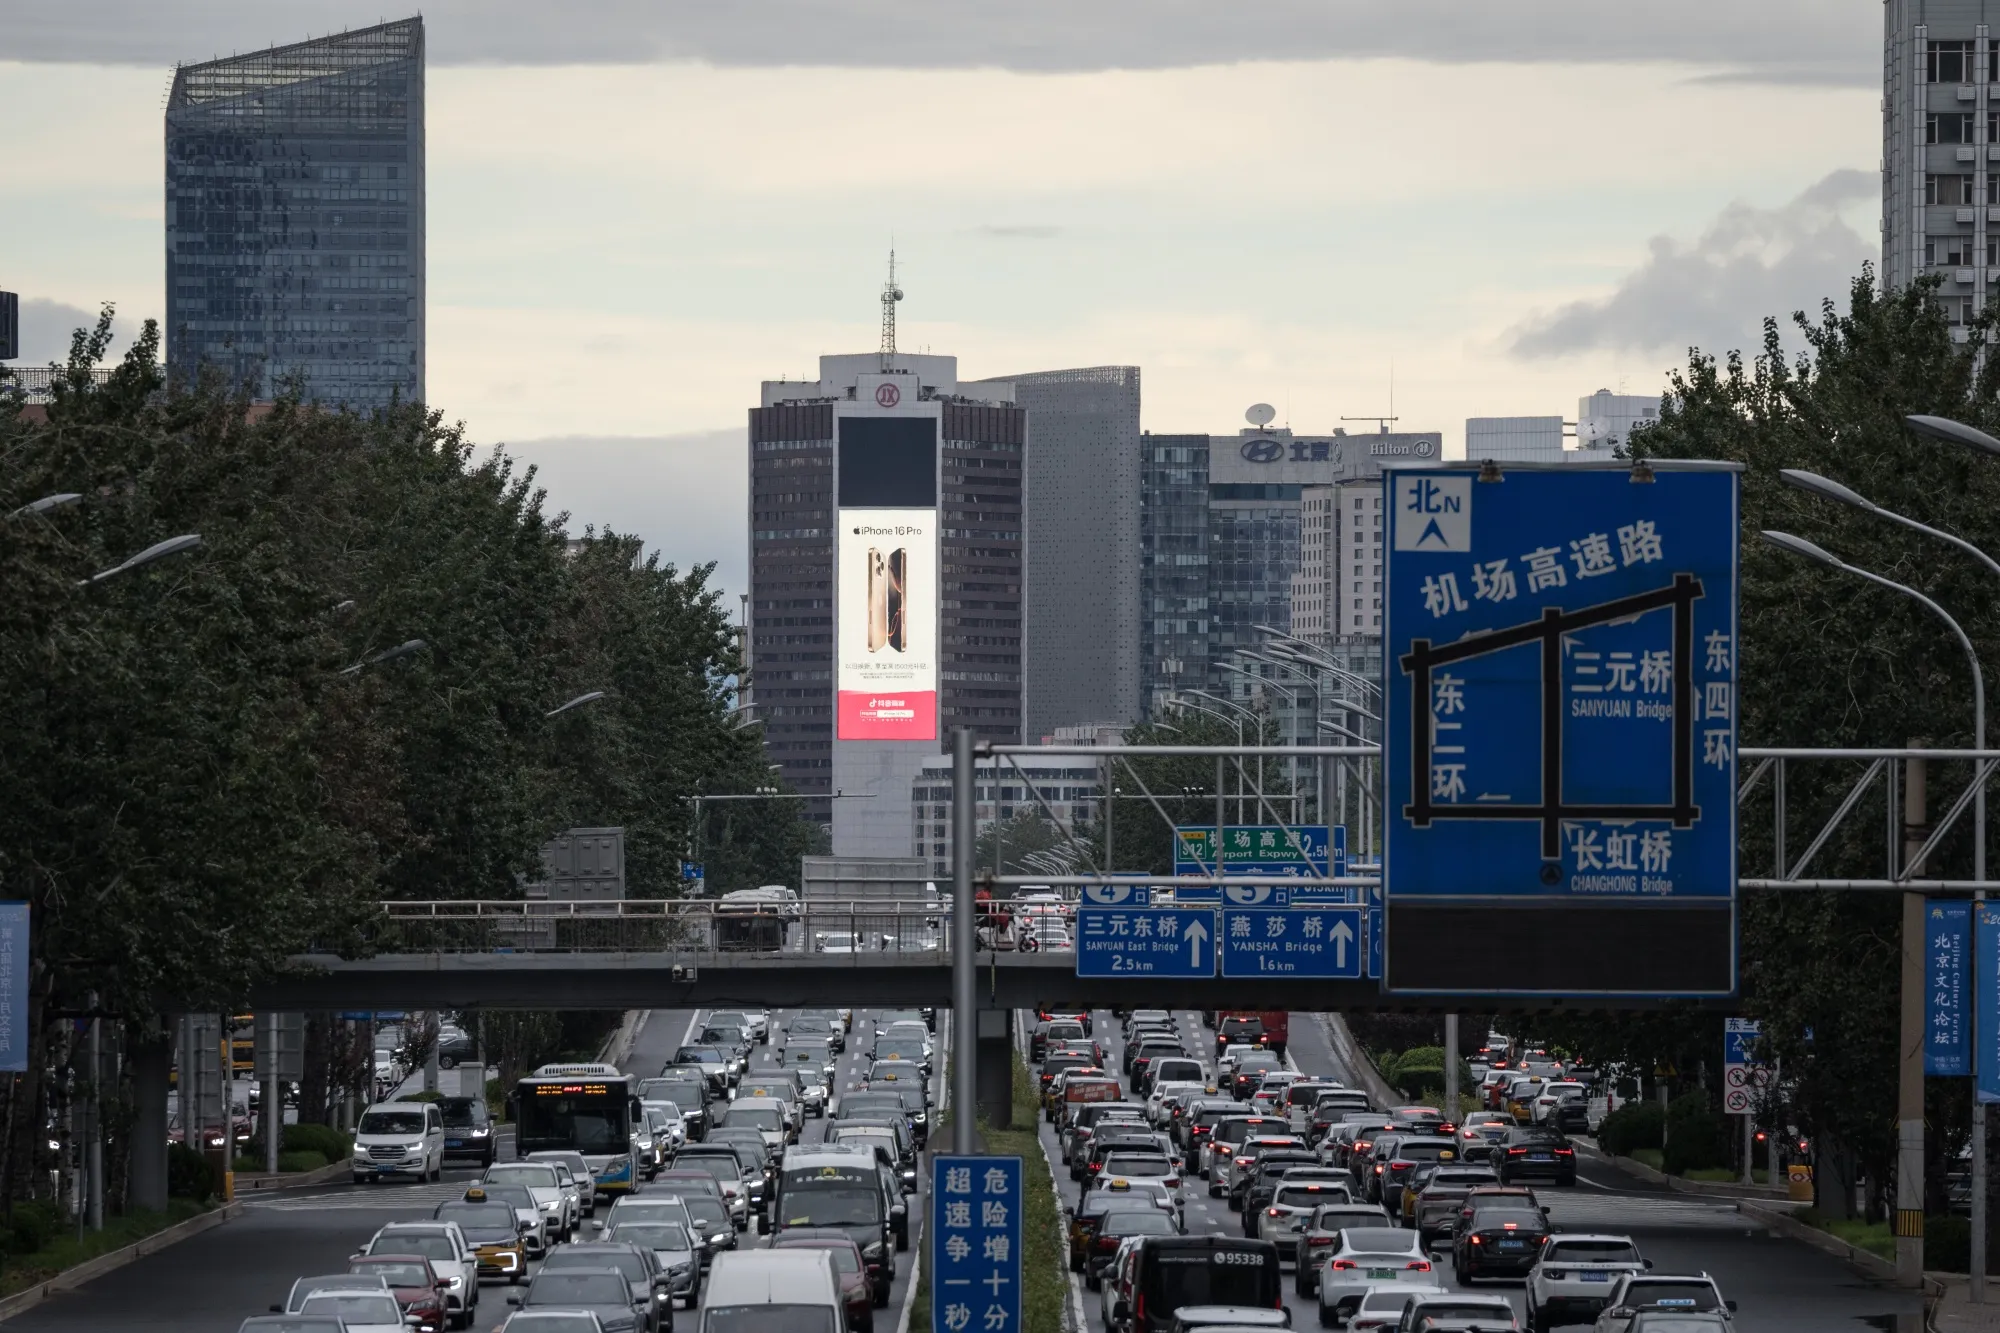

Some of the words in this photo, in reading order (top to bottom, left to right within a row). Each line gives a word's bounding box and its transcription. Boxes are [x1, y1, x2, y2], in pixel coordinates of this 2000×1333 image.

[1370, 443, 1409, 456] Hilton
[1407, 478, 1442, 514] 北
[1443, 496, 1460, 513] N
[861, 527, 893, 535] iPhone
[895, 526, 905, 536] 16
[906, 527, 922, 535] Pro
[1420, 519, 1664, 618] 机场高速路
[1571, 650, 1673, 695] 三元桥
[1571, 700, 1631, 718] SANYUAN
[1636, 699, 1673, 720] Bridge
[1704, 630, 1731, 770] 东四环
[1432, 673, 1466, 803] 东二环
[1259, 850, 1298, 859] Expwy
[1571, 829, 1673, 873] 长虹桥
[1571, 875, 1637, 893] CHANGHONG
[1641, 875, 1673, 894] Bridge
[1084, 915, 1178, 938] 三元东桥
[1231, 916, 1323, 938] 燕莎桥
[1086, 941, 1125, 952] SANYUAN
[1127, 941, 1147, 952] East
[1152, 941, 1179, 954] Bridge
[1232, 941, 1278, 952] YANSHA
[1285, 941, 1323, 954] Bridge
[1952, 934, 1961, 969] Beijing
[1933, 932, 1951, 1045] 北京文化论坛
[1952, 972, 1961, 1010] Culture
[1952, 1013, 1961, 1044] Forum
[944, 1167, 972, 1331] 超速争一秒
[981, 1167, 1010, 1330] 危险增十分
[1226, 1253, 1264, 1265] 95338
